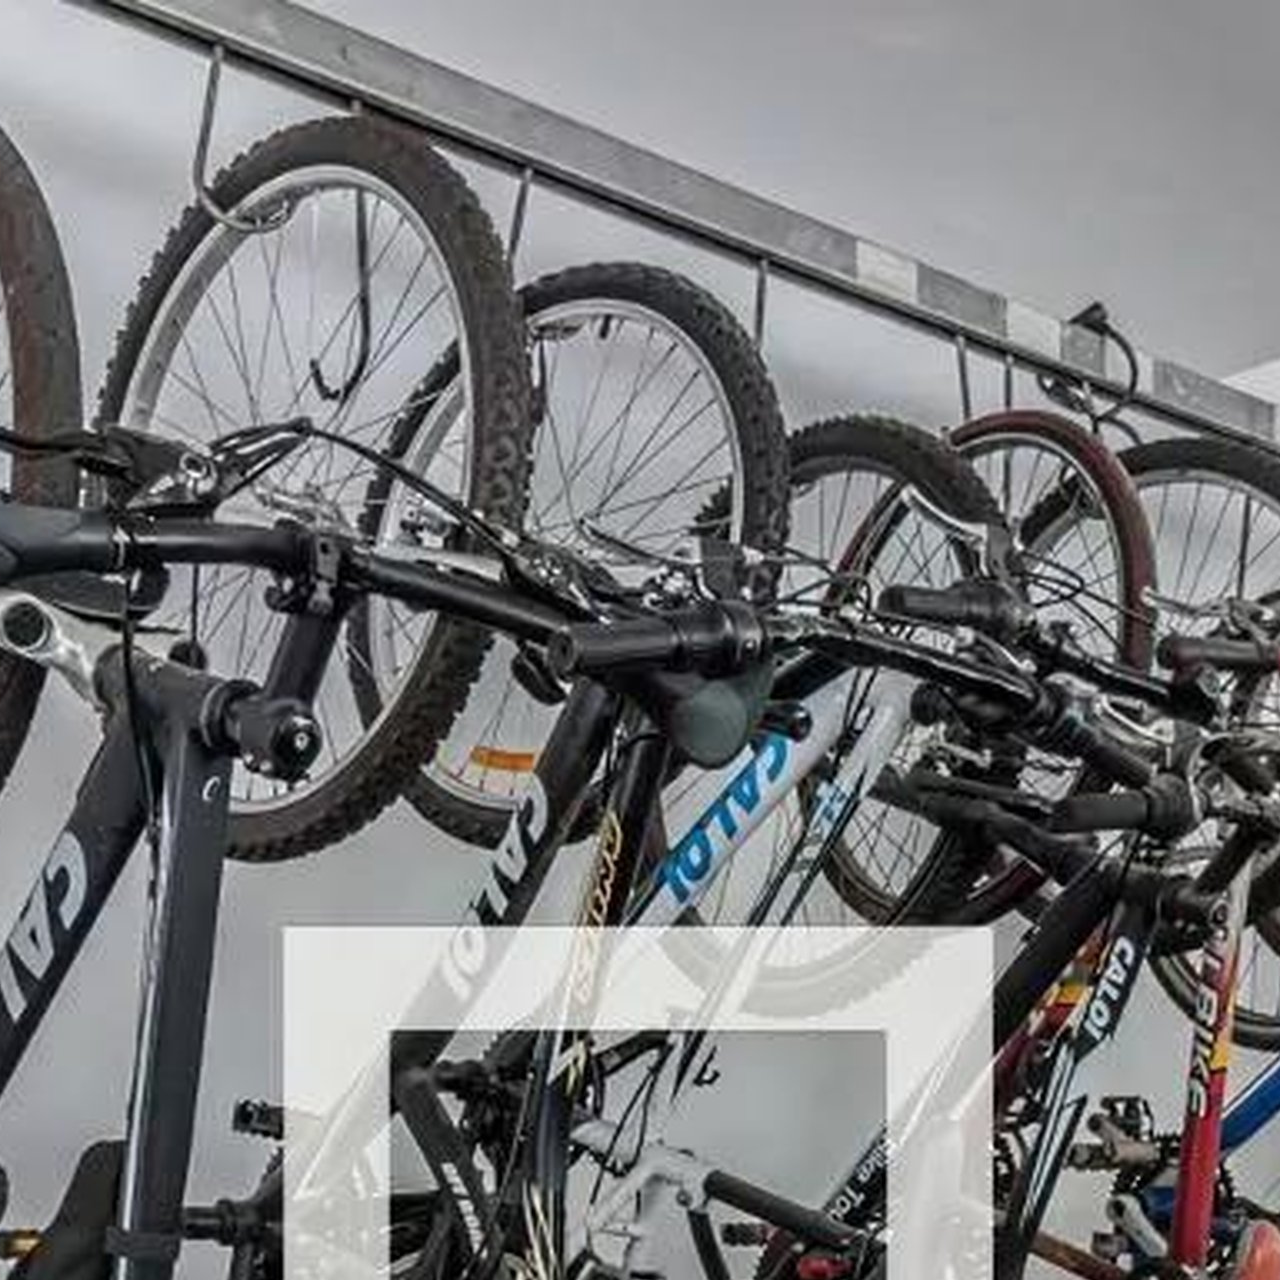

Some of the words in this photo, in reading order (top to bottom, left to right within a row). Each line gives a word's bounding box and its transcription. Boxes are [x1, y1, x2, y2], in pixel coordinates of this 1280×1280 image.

[441, 772, 549, 999] CALOI
[662, 731, 792, 903] CALOI
[1083, 935, 1136, 1040] CALOI
[826, 1186, 866, 1223] Tou
